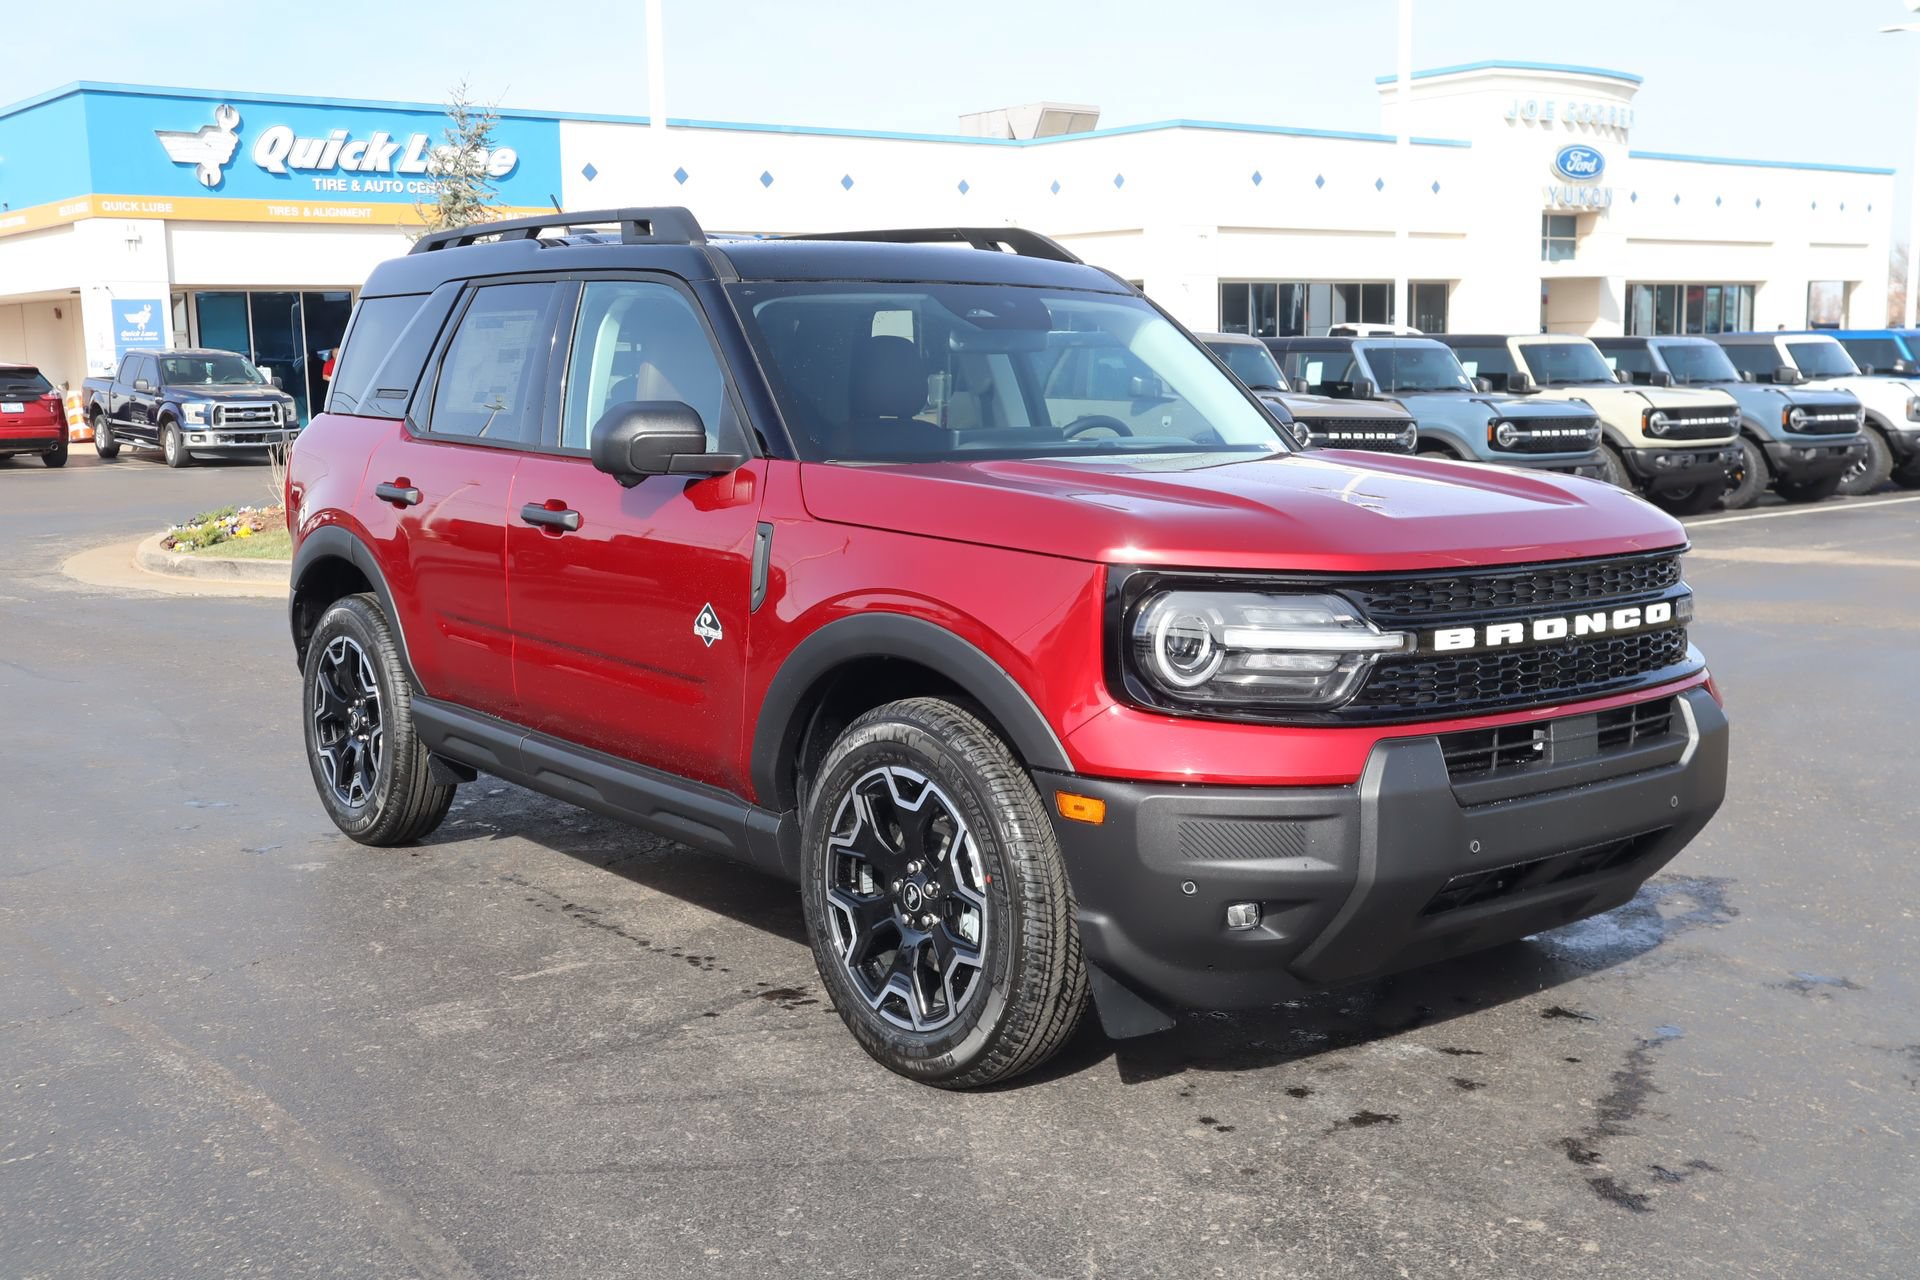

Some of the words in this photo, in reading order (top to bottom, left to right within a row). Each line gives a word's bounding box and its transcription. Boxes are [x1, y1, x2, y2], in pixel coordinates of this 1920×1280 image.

[1506, 99, 1555, 120] JOE
[252, 125, 401, 174] Quick
[1566, 150, 1599, 173] Ford
[312, 178, 348, 192] TIRE
[351, 179, 361, 192] &
[364, 180, 404, 193] AUTO
[1547, 185, 1612, 206] YUKON
[101, 201, 140, 212] QUICK
[142, 202, 174, 213] LUBE
[267, 205, 299, 216] TIRES
[303, 207, 311, 217] &
[313, 207, 372, 218] ALIGNMENT
[1434, 602, 1672, 652] BRONCO
